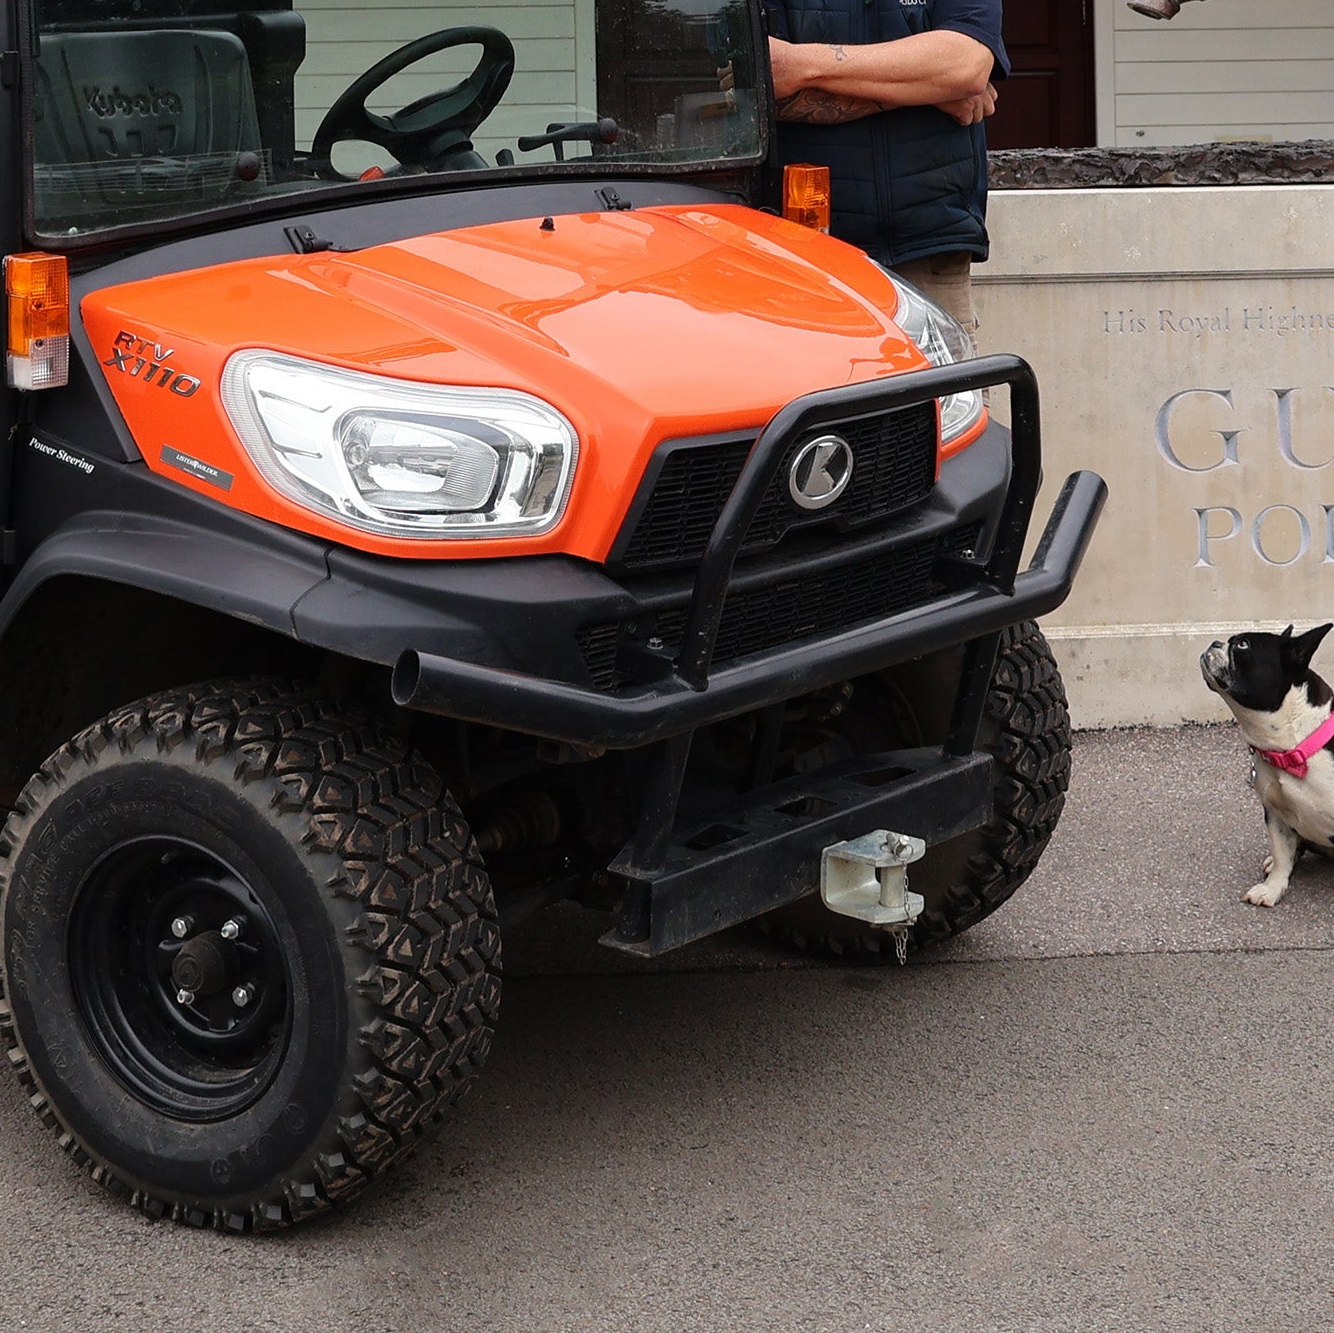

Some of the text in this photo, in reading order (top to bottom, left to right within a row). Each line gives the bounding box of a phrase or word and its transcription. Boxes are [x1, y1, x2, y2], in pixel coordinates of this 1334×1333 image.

[83, 86, 183, 119] Kubota
[1103, 309, 1147, 334] His
[1158, 307, 1230, 339] Royal
[114, 330, 175, 362] RTV
[103, 347, 203, 398] X1110
[29, 437, 95, 474] Power Steering
